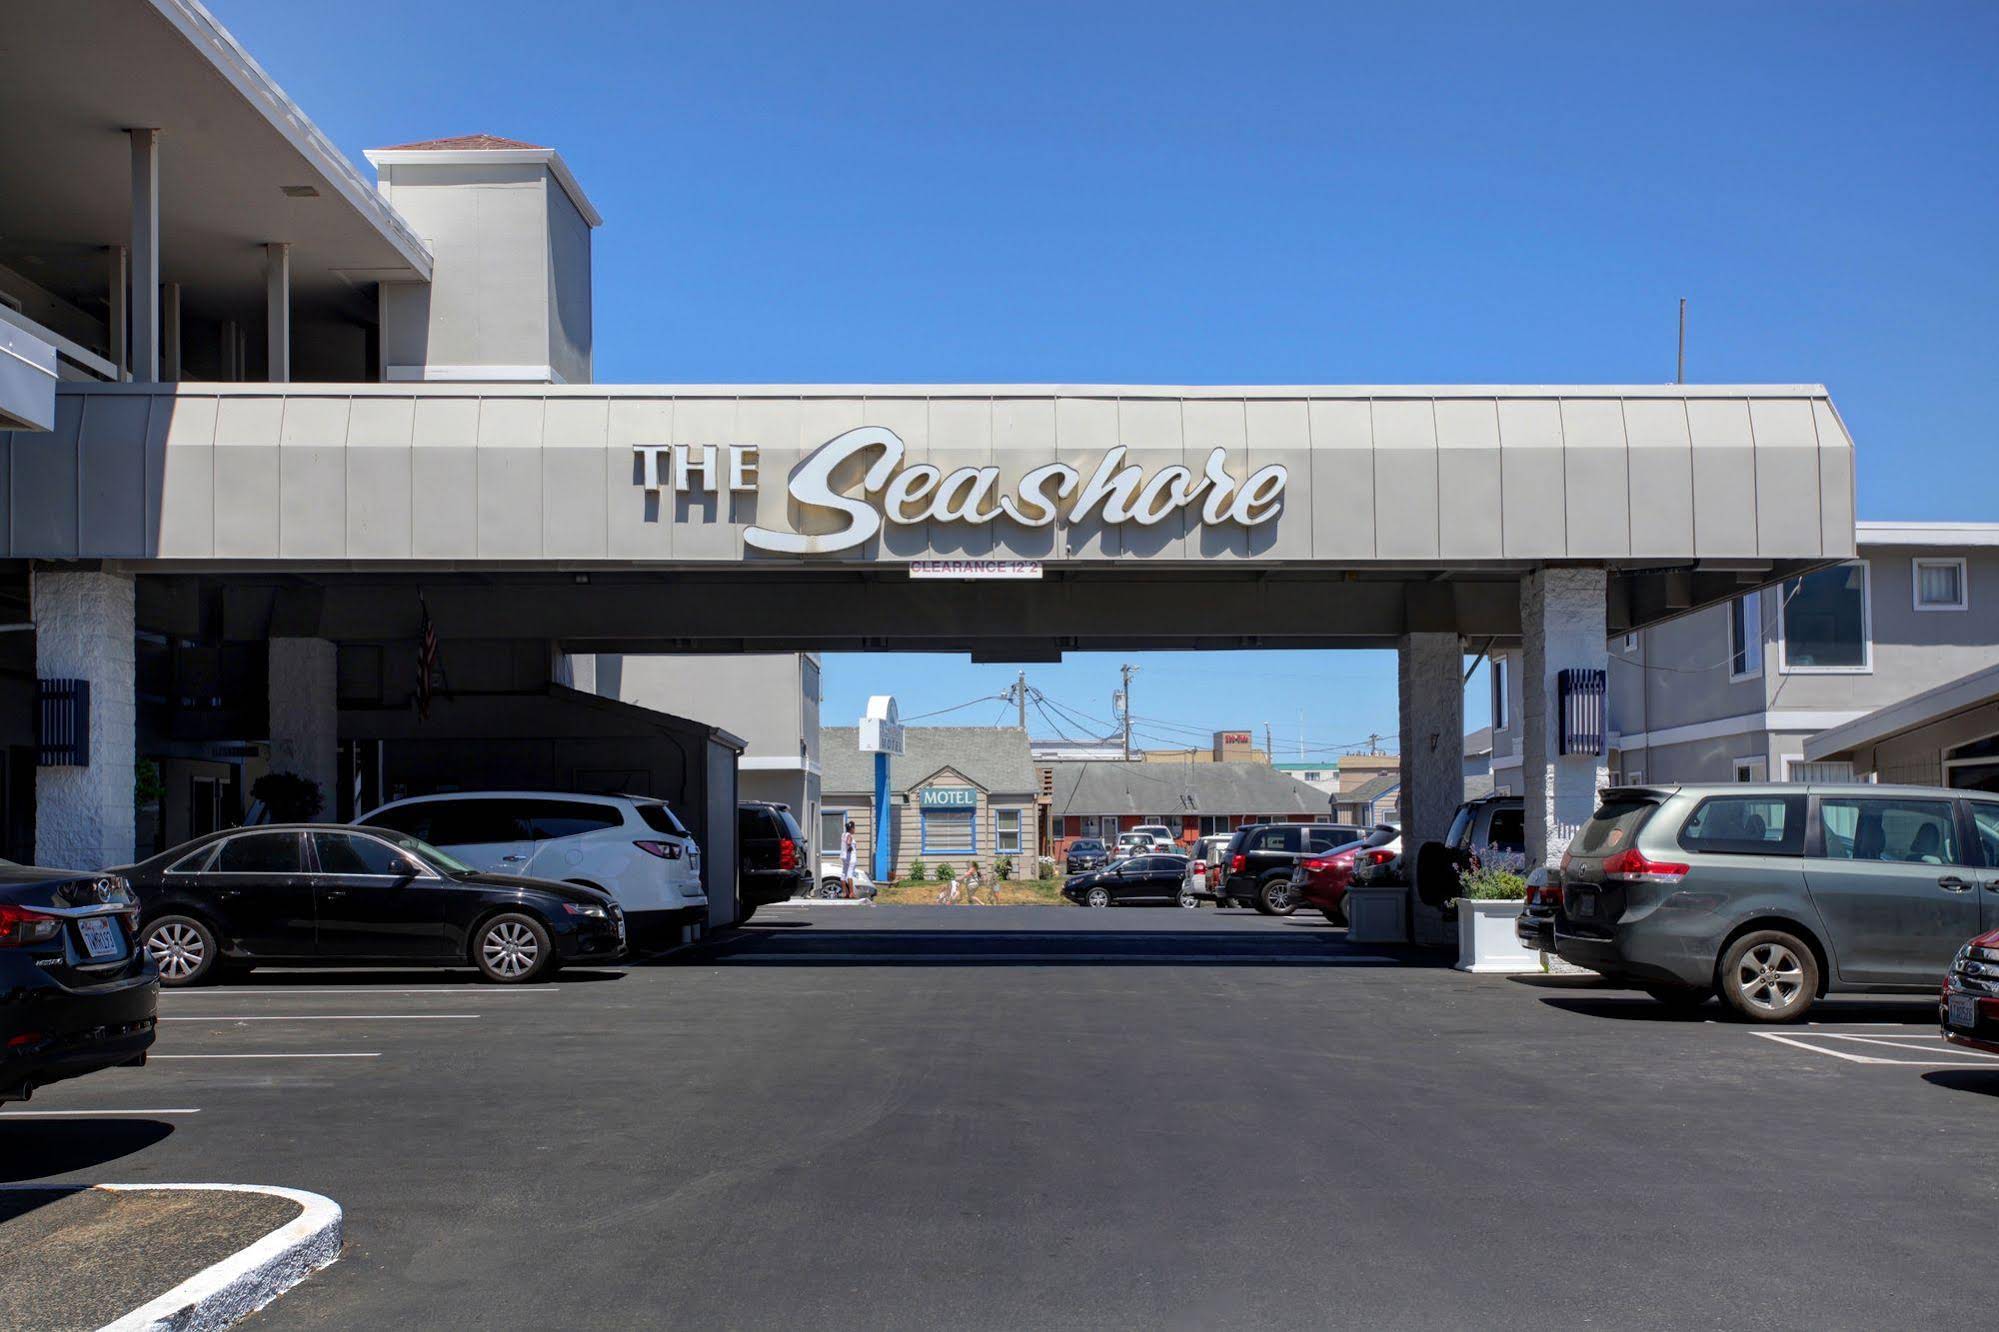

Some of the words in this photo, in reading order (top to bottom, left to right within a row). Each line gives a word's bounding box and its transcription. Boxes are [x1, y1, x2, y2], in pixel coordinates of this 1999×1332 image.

[632, 444, 759, 492] THE
[743, 425, 1287, 554] Seashore
[911, 561, 1007, 573] CLEARANCE
[924, 791, 973, 804] MOTEL
